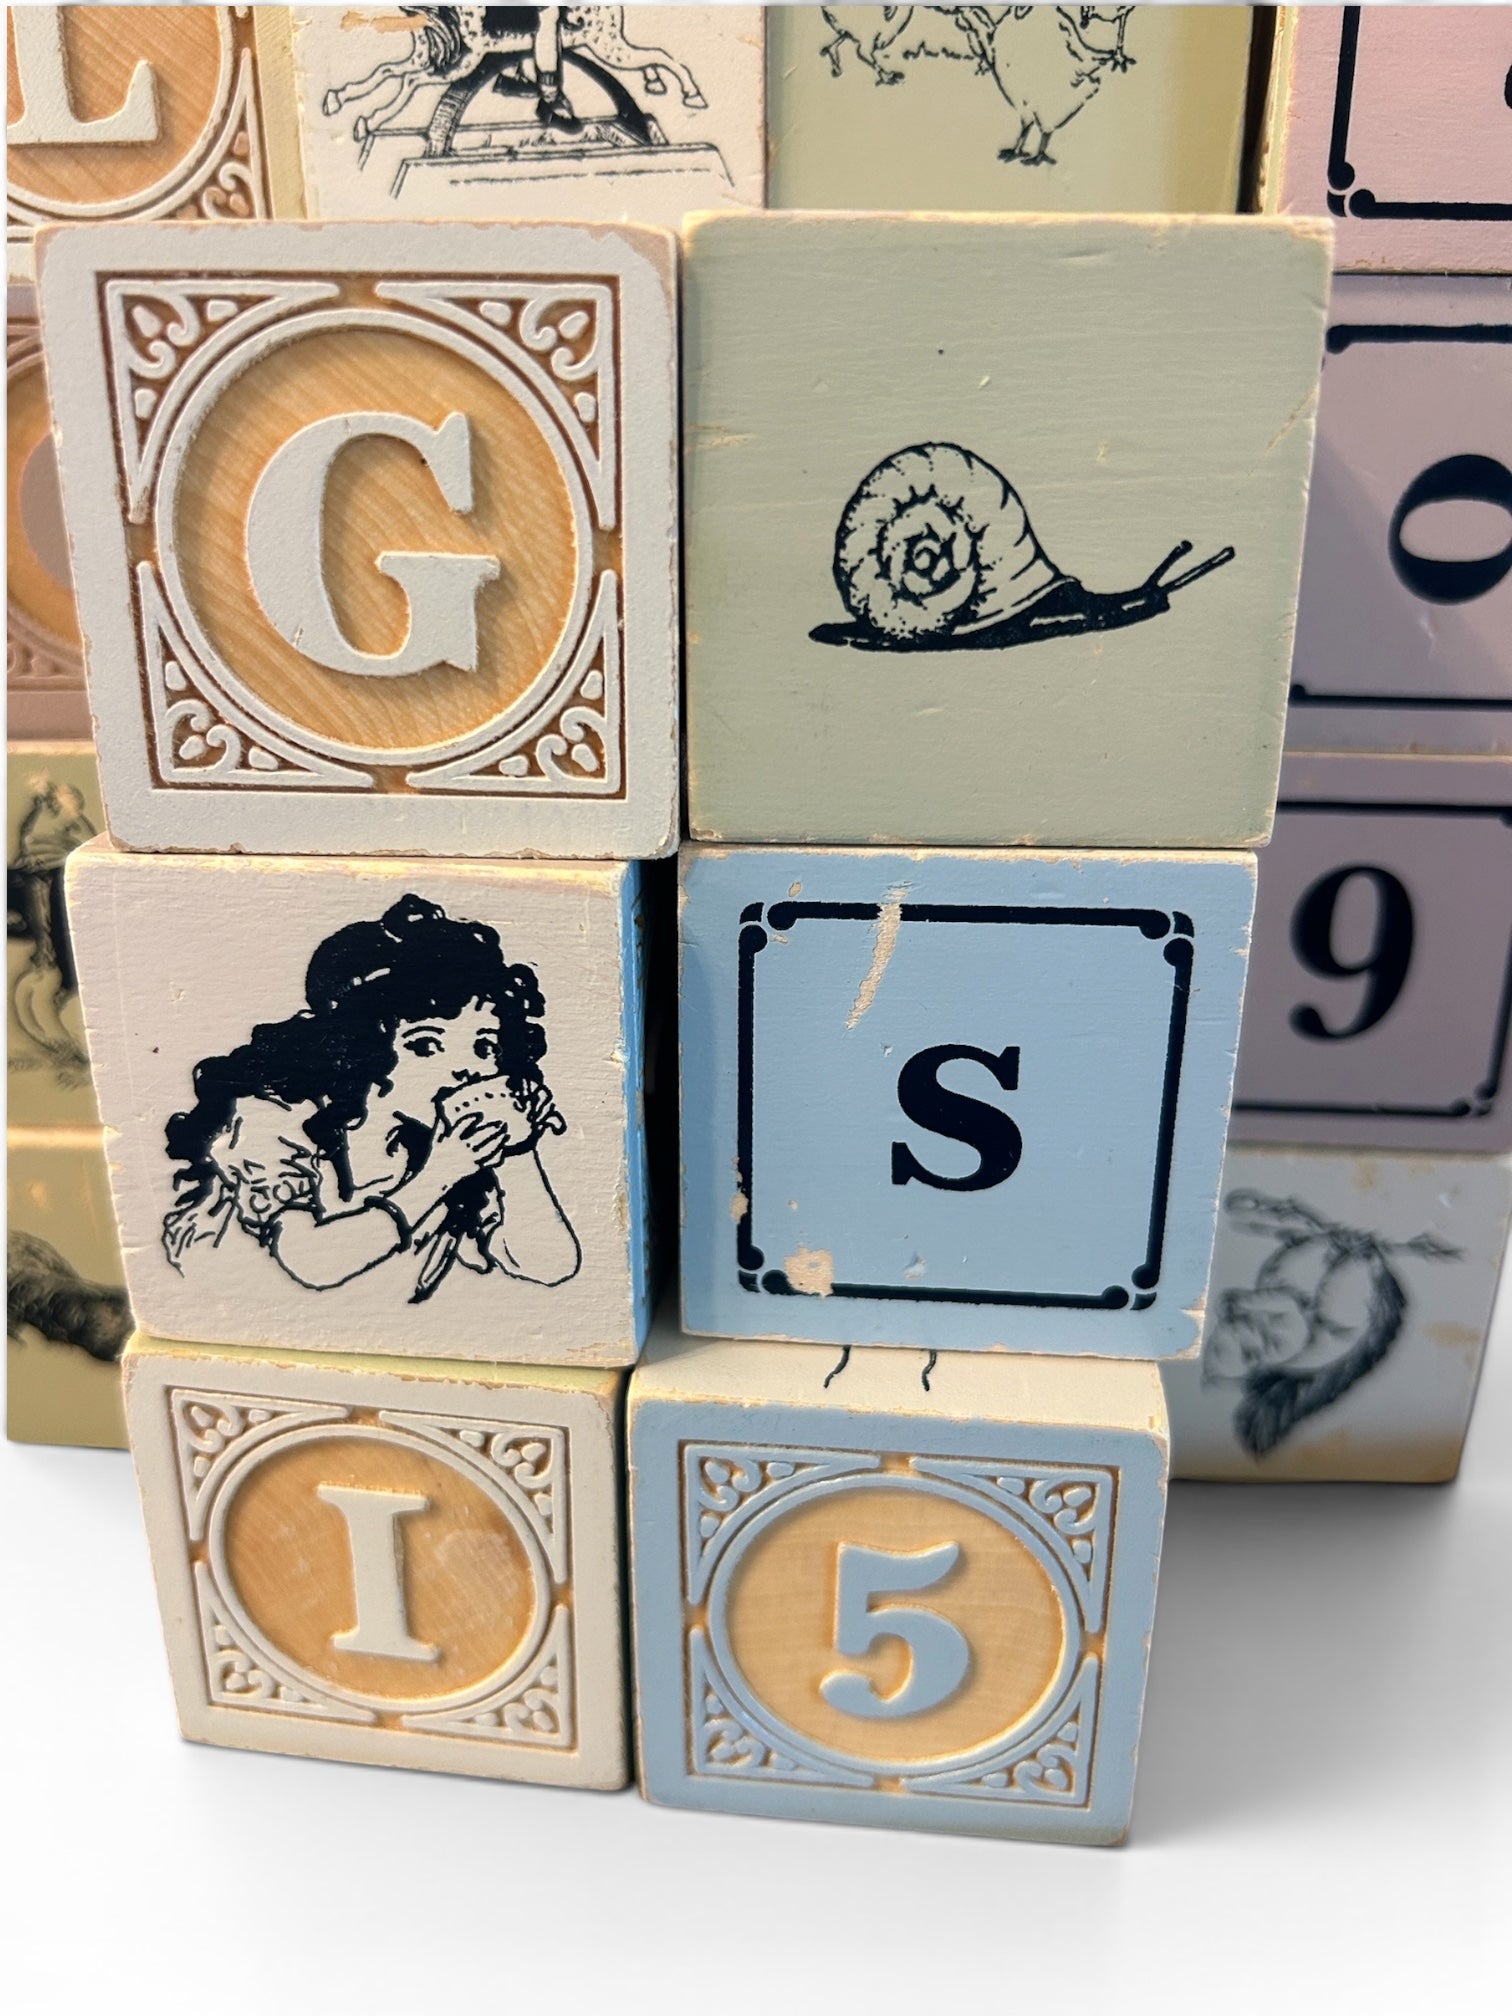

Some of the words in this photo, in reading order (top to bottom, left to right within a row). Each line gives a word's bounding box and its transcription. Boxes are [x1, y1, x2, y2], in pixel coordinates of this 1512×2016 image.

[243, 411, 500, 677] G
[1289, 864, 1415, 1042] 9
[890, 1043, 1023, 1191] S
[316, 1483, 440, 1662] I
[819, 1540, 971, 1719] 5
